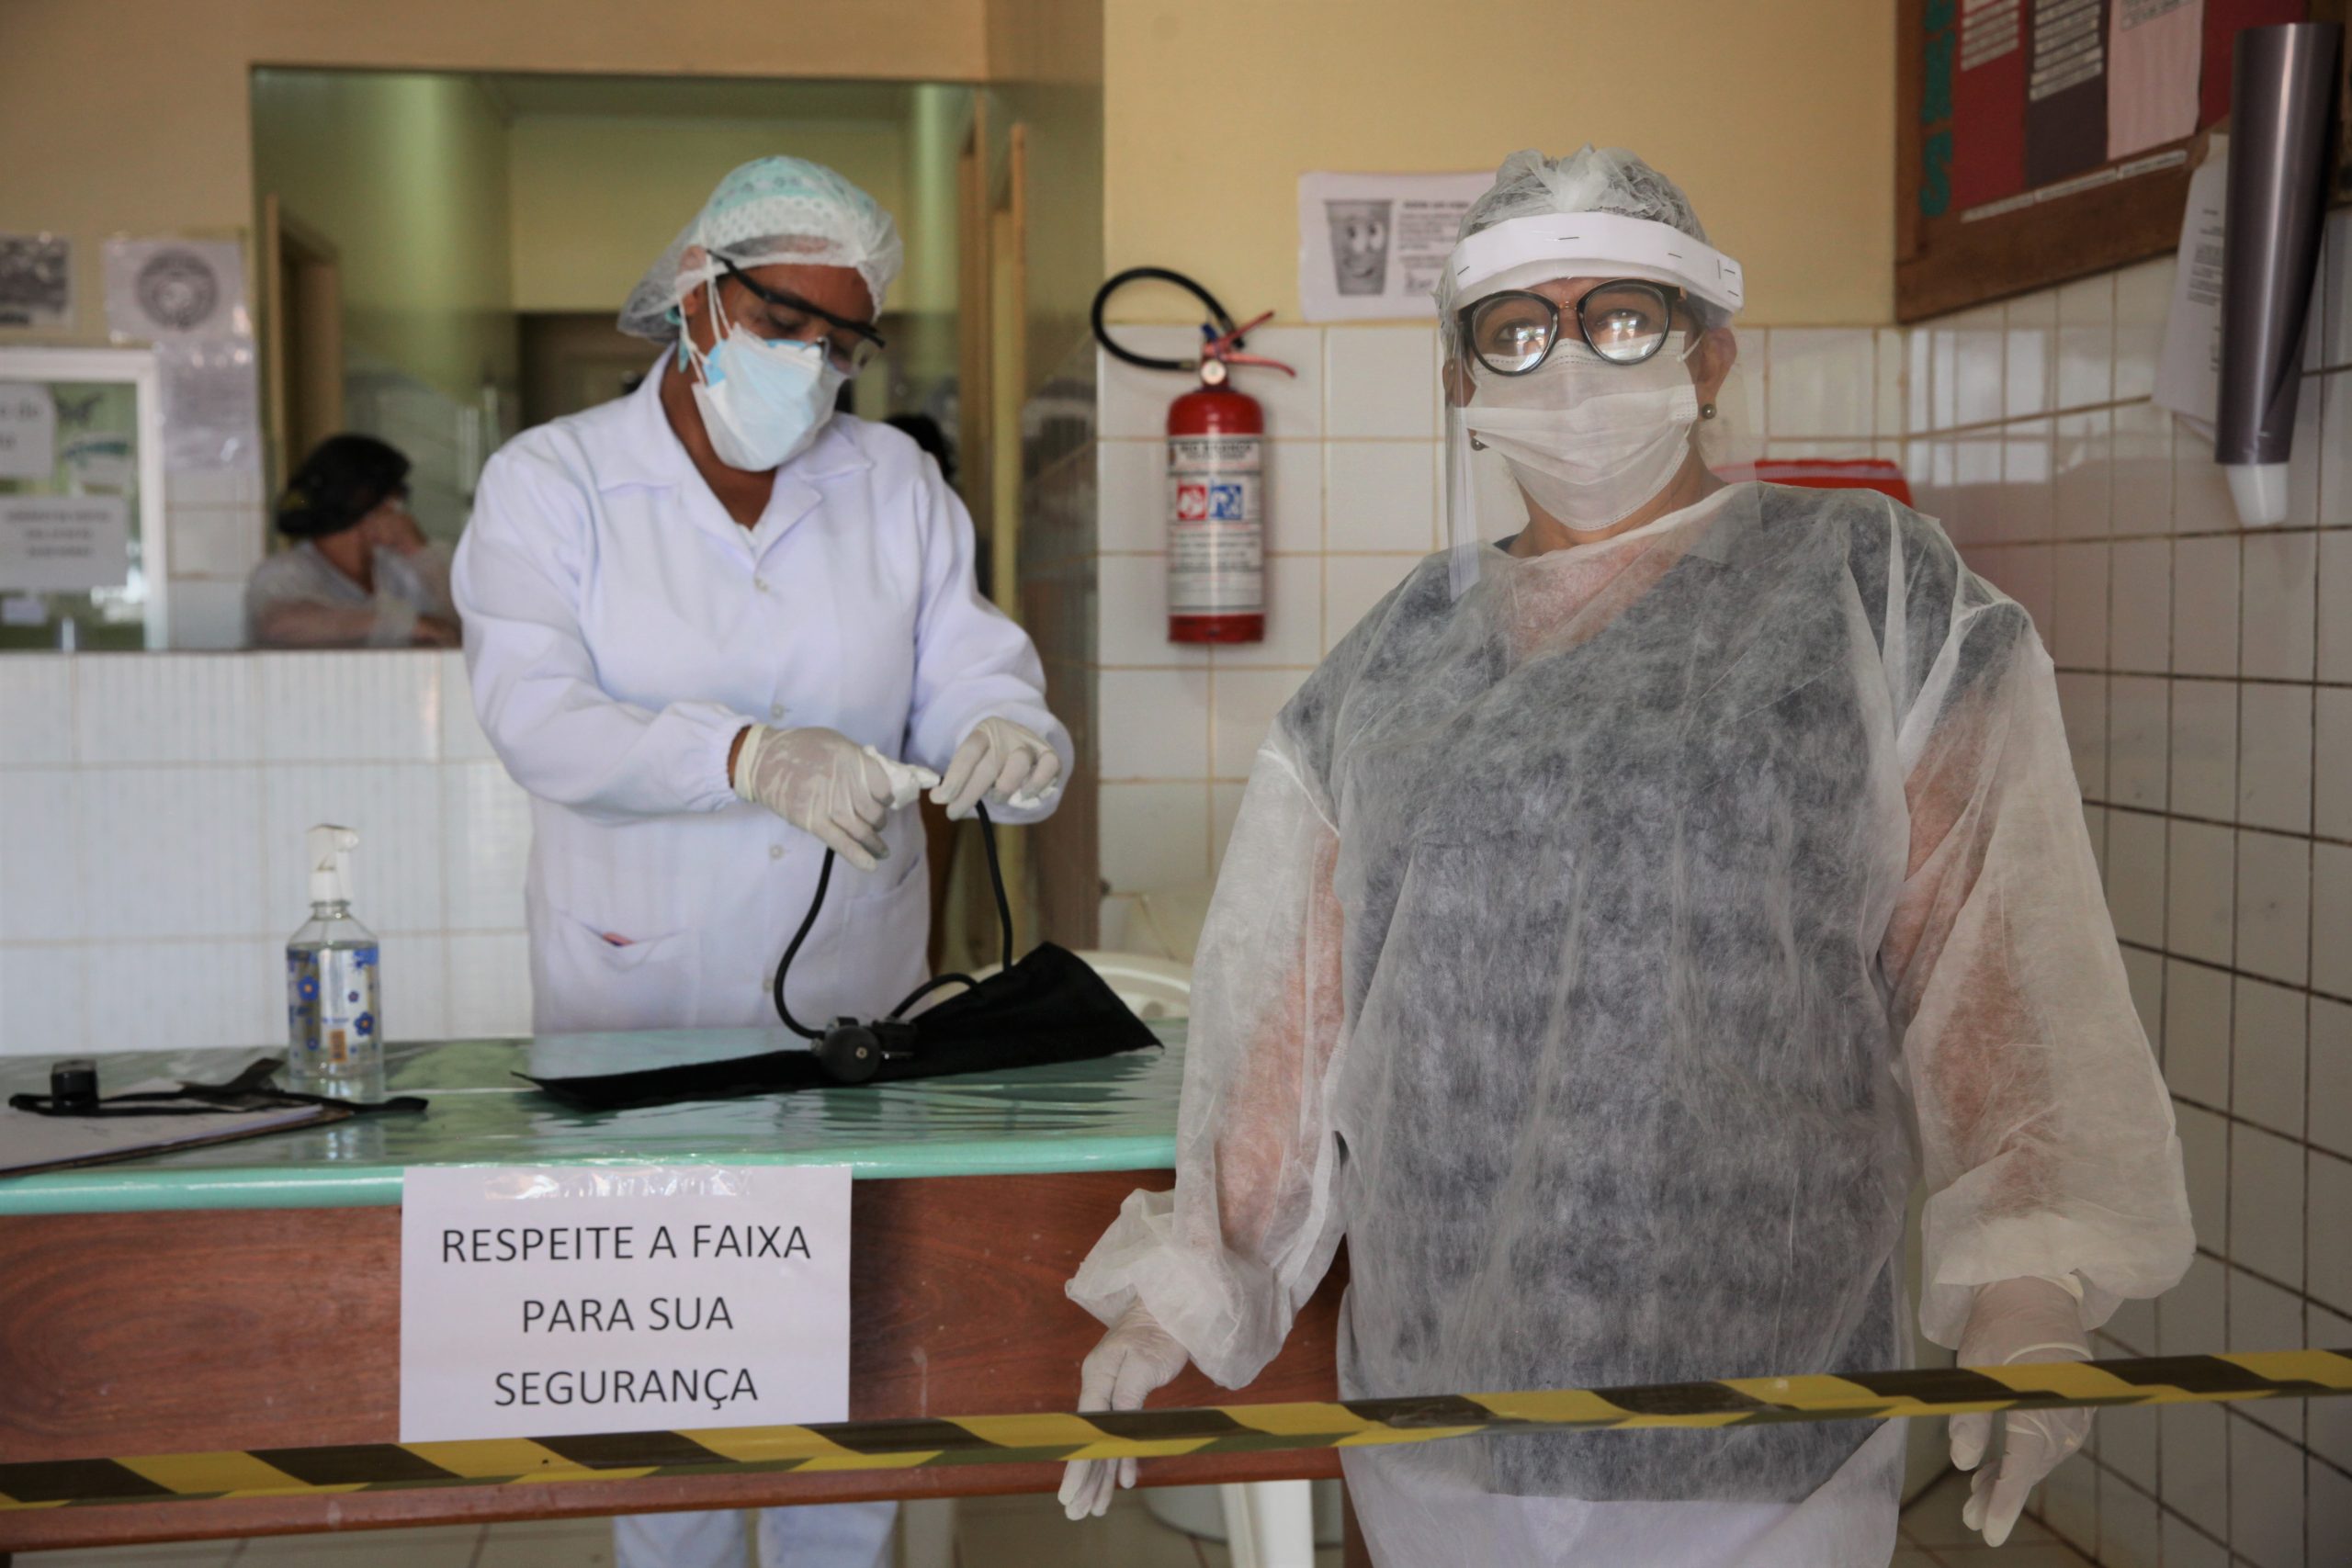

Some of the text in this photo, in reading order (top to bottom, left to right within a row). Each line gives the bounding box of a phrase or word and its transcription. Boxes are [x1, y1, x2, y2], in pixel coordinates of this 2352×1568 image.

[443, 1224, 811, 1263] RESPEITE A FAIXA
[523, 1296, 734, 1334] PARA SUA
[494, 1368, 758, 1411] SEGURANÇA
